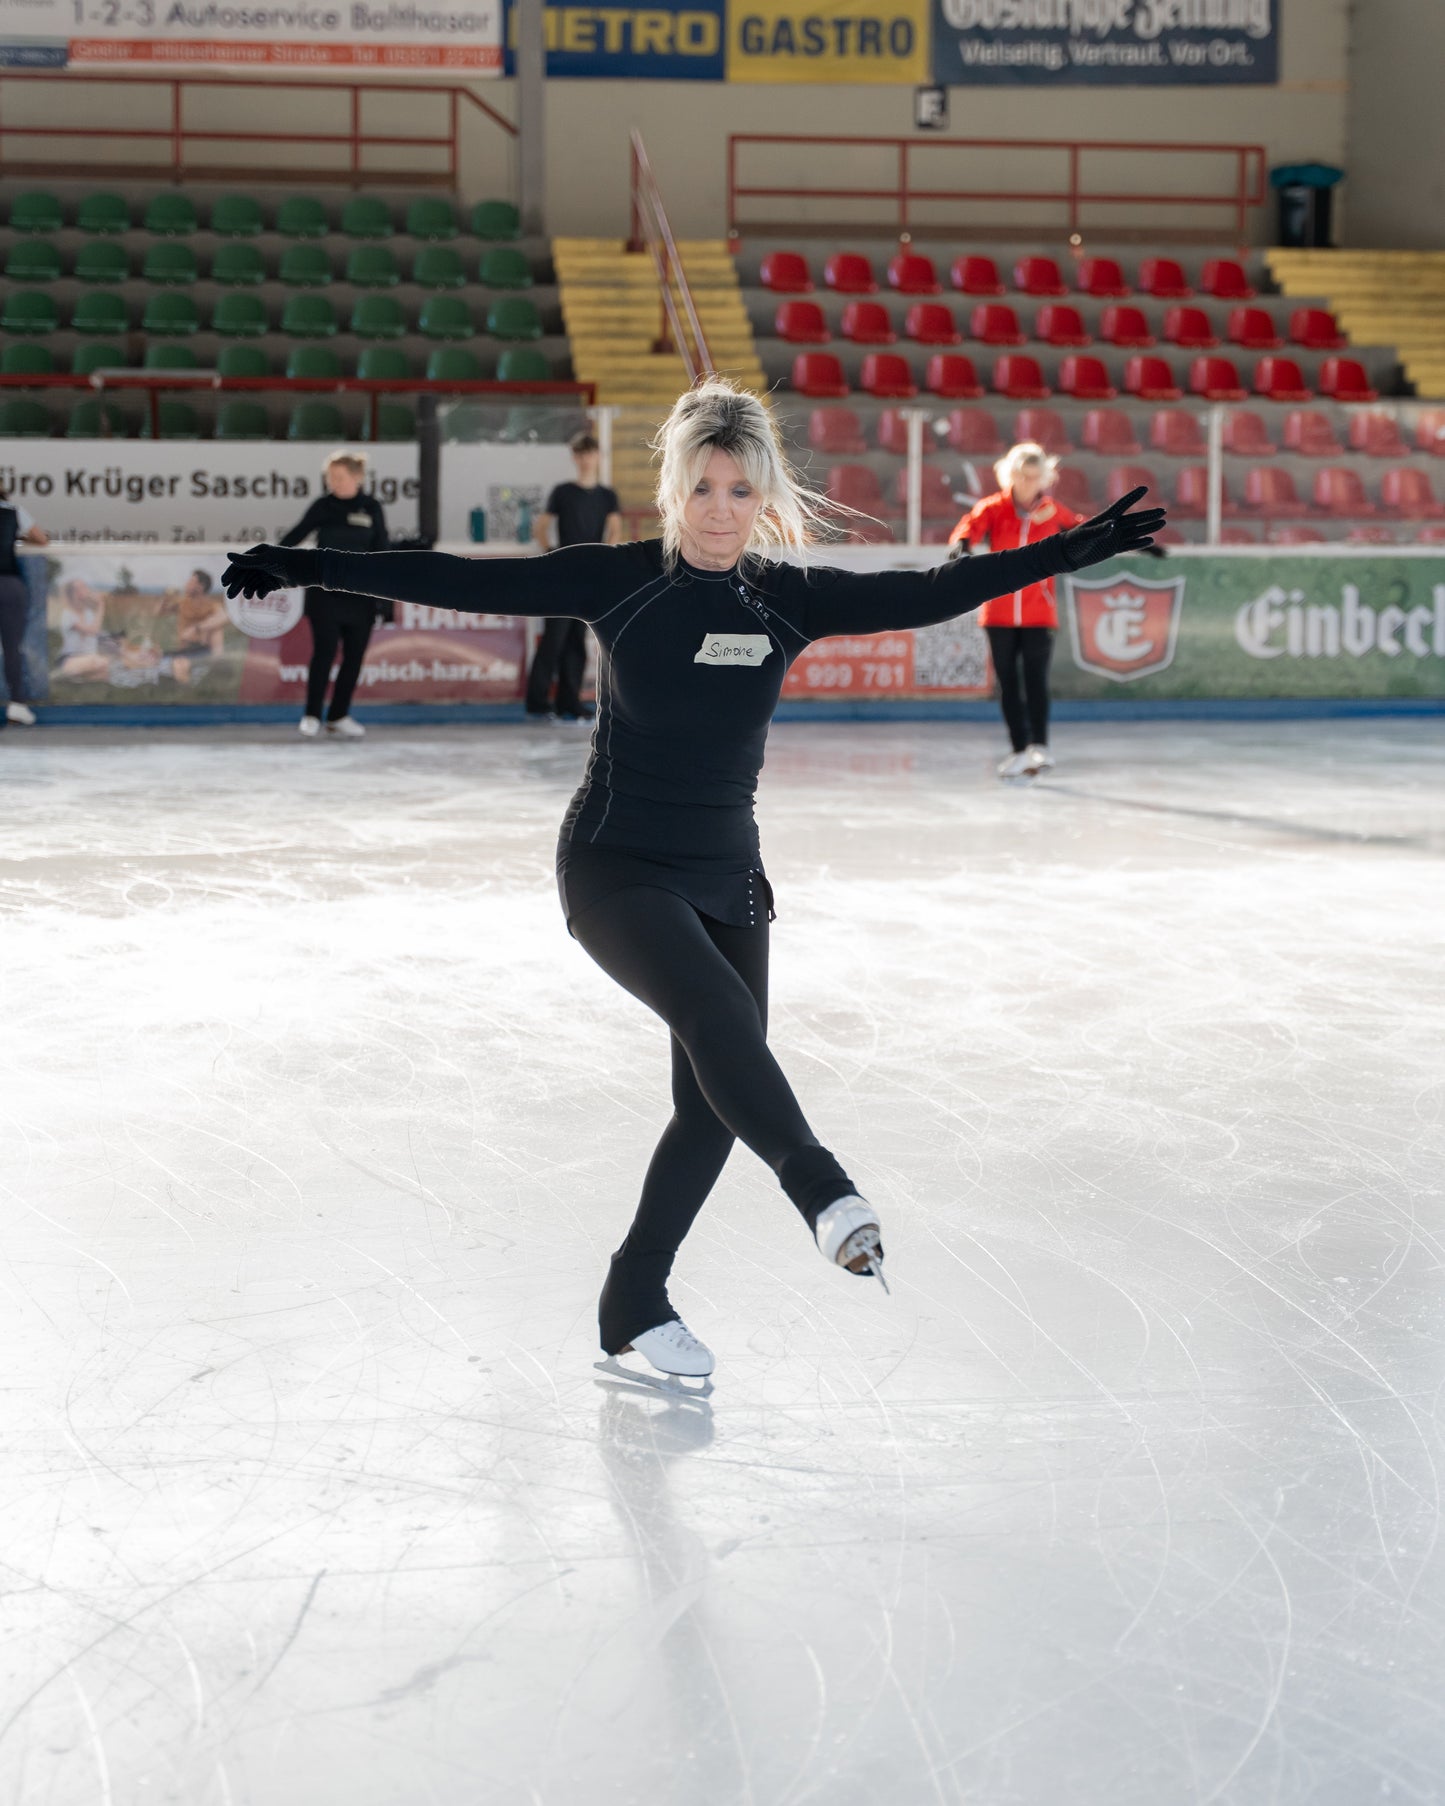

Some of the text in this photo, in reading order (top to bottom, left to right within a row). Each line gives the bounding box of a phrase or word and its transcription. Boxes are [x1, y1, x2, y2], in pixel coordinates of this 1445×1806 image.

[166, 0, 339, 30] Autoservice
[351, 4, 490, 32] Balthasar
[740, 15, 914, 58] GASTRO
[1168, 38, 1207, 66] Vor
[1208, 38, 1256, 67] Ort.
[65, 466, 182, 503] Krüger
[191, 471, 311, 498] Sascha
[705, 642, 755, 658] Simone
[806, 663, 853, 688] 999
[862, 663, 905, 688] 781
